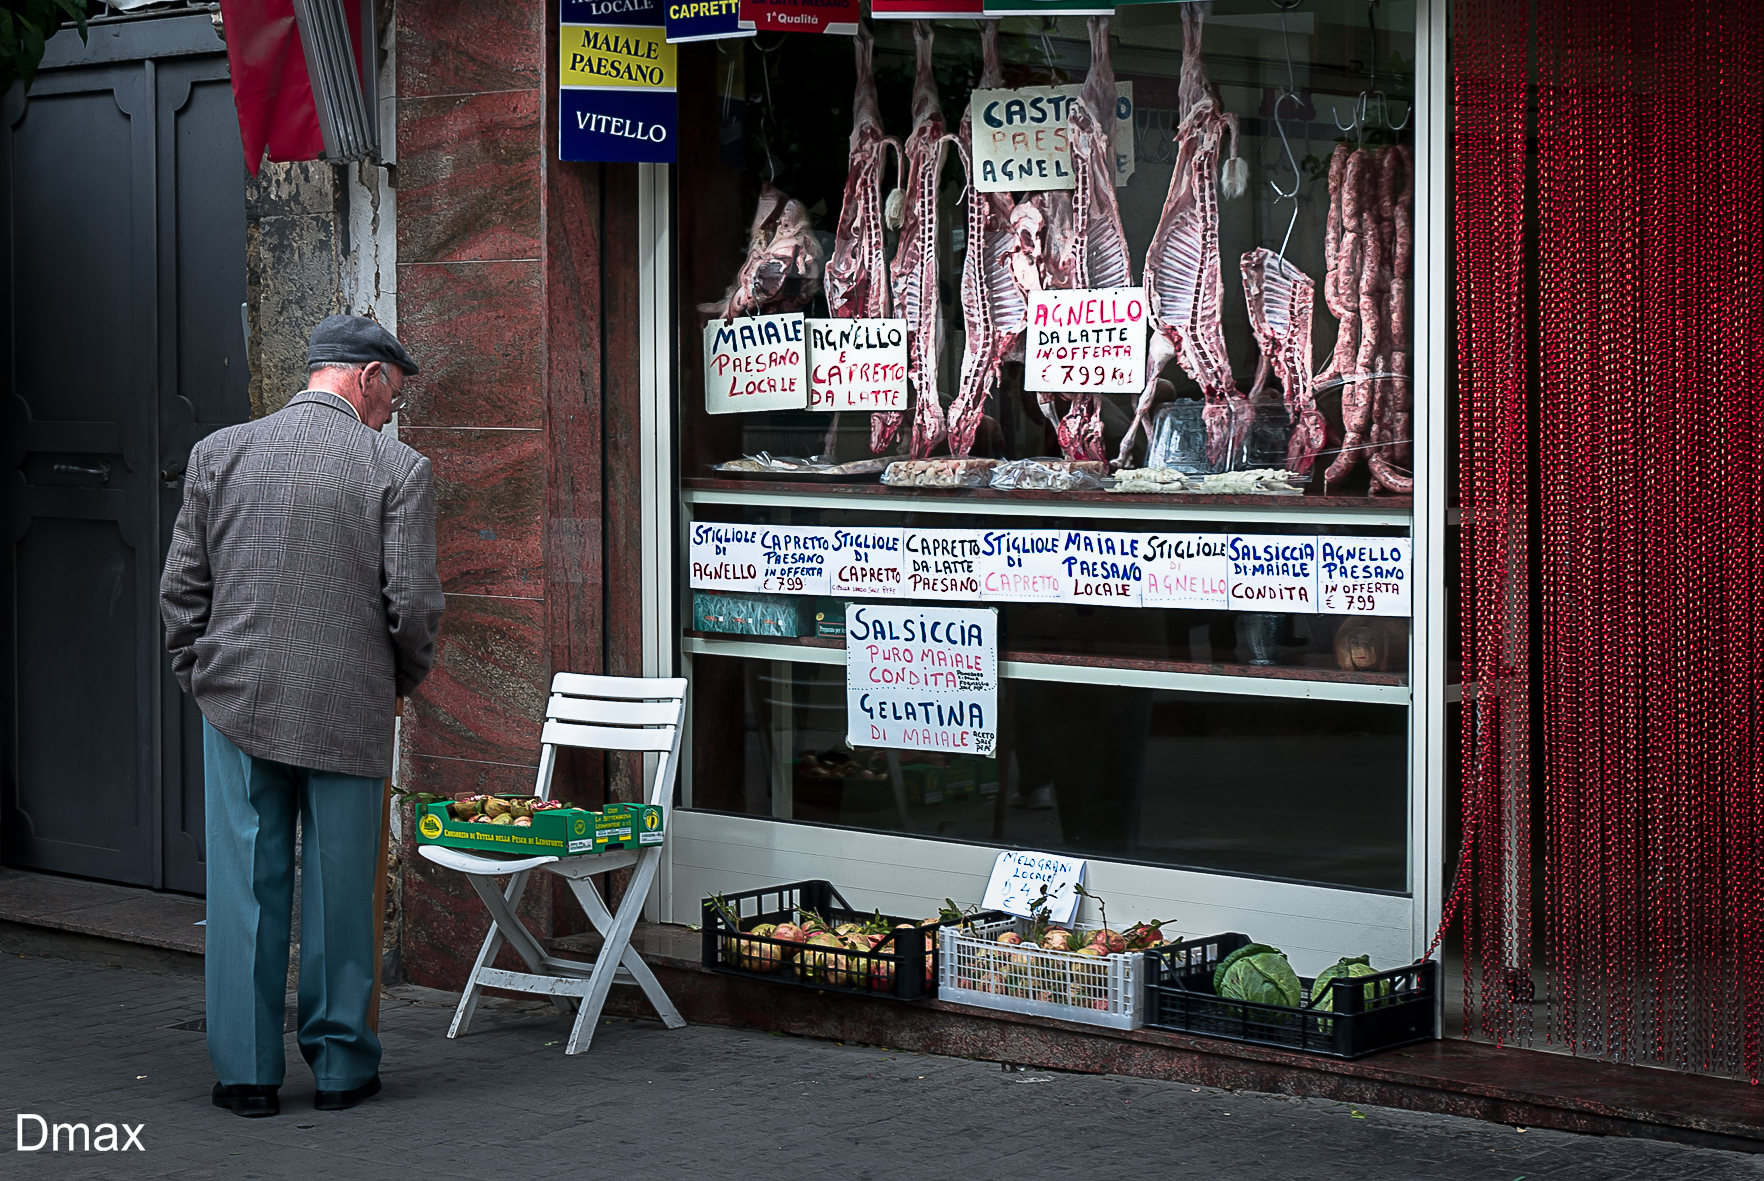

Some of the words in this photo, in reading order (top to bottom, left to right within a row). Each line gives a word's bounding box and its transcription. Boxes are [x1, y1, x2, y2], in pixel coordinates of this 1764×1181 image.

[591, 0, 653, 15] LOCALE
[670, 0, 739, 19] CAPRETT
[581, 29, 659, 59] MAIALE
[569, 53, 664, 85] PAESANO
[575, 111, 667, 143] VITELLO
[1034, 299, 1142, 327] AGNELLO
[712, 319, 803, 354] MAIALE
[812, 325, 902, 351] AGNELLO
[1039, 330, 1060, 345] DA
[1068, 327, 1128, 344] LATTE
[710, 348, 799, 376] PAESANO
[839, 351, 846, 363] E
[812, 362, 905, 386] CAPRETTO
[1061, 365, 1105, 386] 799
[728, 376, 798, 398] LOCALE
[810, 389, 835, 407] DA
[848, 389, 900, 406] LATTE
[693, 525, 757, 546] STIGLIOLE
[760, 531, 829, 551] CAPRETTO
[832, 530, 899, 552] STIGLIOLE
[906, 534, 980, 557] CAPRETTO
[981, 532, 1059, 556] STIGLIOLE
[1064, 532, 1139, 557] MAIALE
[715, 545, 727, 556] DI
[763, 551, 825, 565] PAESANO
[854, 550, 868, 563] DI
[1143, 535, 1226, 562] STIGLIOLE
[1228, 537, 1314, 562] SALSICCIA
[1322, 542, 1401, 564] AGNELLO
[1007, 555, 1022, 567] DI
[1062, 556, 1142, 581] PAESANO
[1169, 560, 1181, 571] DI
[1322, 562, 1404, 580] PAESANO
[693, 562, 757, 582] AGNELLO
[780, 566, 823, 578] OFFERTA
[838, 565, 901, 584] CAPRETTO
[985, 572, 1059, 592] CAPRETTO
[776, 577, 803, 591] 799
[908, 574, 979, 593] PAESANO
[1073, 579, 1131, 597] LOCALE
[1148, 573, 1227, 595] AGNELLO
[1231, 582, 1309, 603] CONDITA
[1325, 583, 1338, 595] IN
[1343, 582, 1400, 595] OFFERTA
[1345, 595, 1375, 611] 799
[850, 608, 983, 647] SALSICCIA
[865, 644, 914, 663] PURO
[920, 648, 982, 671] MAIALE
[869, 666, 957, 688] CONDITA
[860, 693, 984, 729] GELATINA
[870, 724, 887, 741] DI
[903, 729, 970, 748] MAIALE
[973, 731, 994, 739] ACETO
